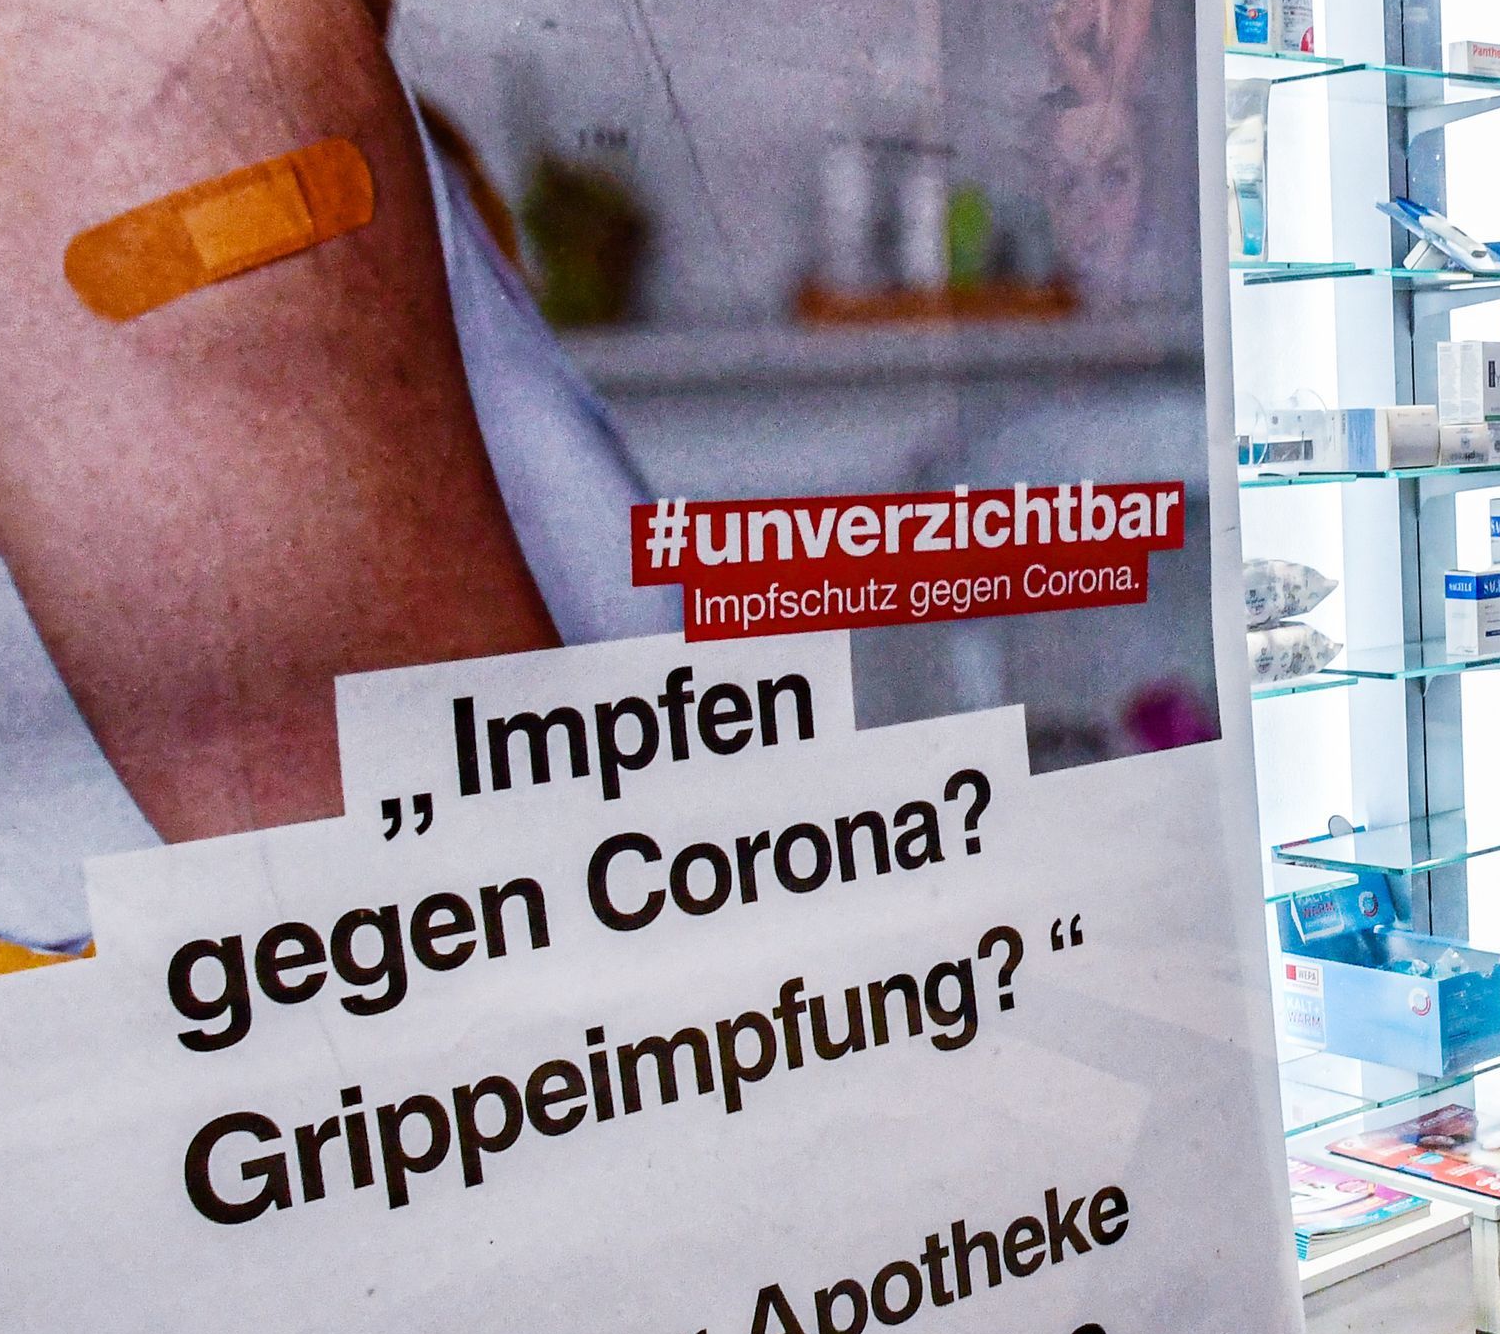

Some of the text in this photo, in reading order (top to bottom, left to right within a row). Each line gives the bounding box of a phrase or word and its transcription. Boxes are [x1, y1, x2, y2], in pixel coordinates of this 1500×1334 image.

[645, 477, 1181, 569] #unverzichtbar
[693, 561, 1141, 631] Impfschutz gegen Corona.
[165, 765, 995, 1054] gegen Corona?
[182, 923, 1025, 1227] Grippeimpfung?
